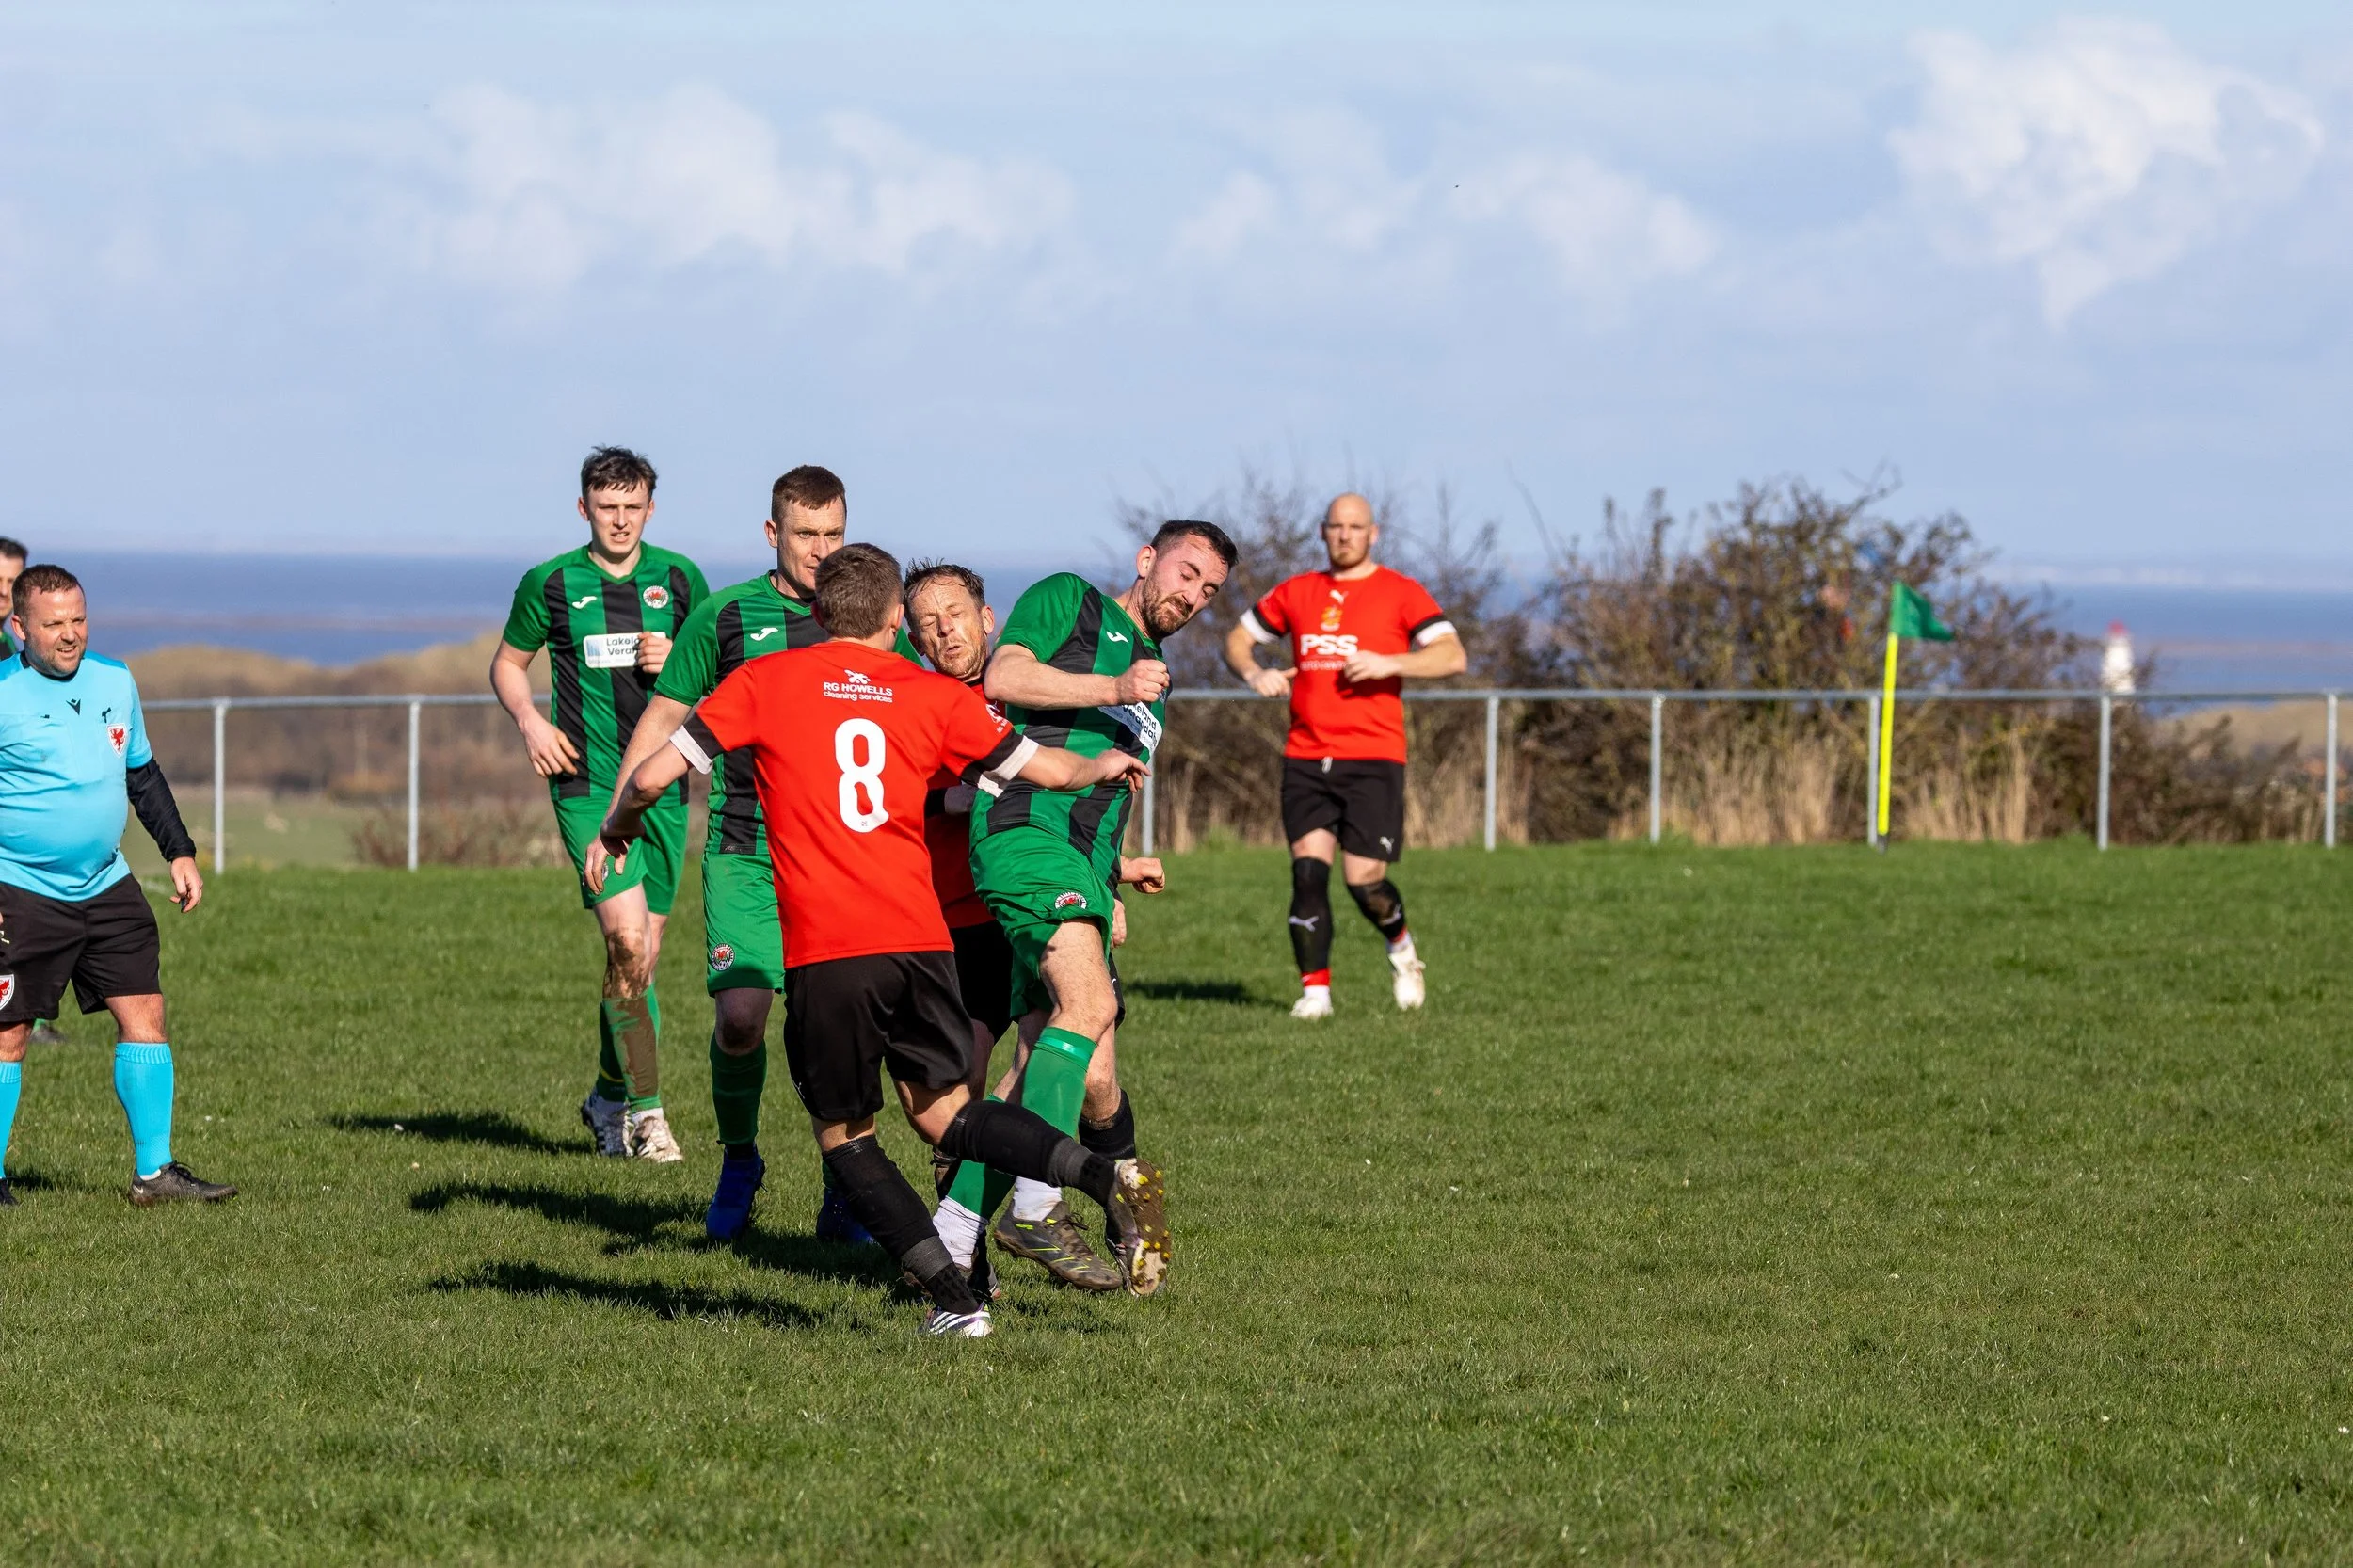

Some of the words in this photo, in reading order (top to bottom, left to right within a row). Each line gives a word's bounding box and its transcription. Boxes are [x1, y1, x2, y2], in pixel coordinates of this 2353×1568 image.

[1300, 633, 1358, 656] PSS
[823, 681, 840, 692] RG
[841, 683, 893, 696] HOWELLS
[824, 691, 857, 701] cleaning
[858, 694, 893, 703] services
[835, 717, 889, 833] 8
